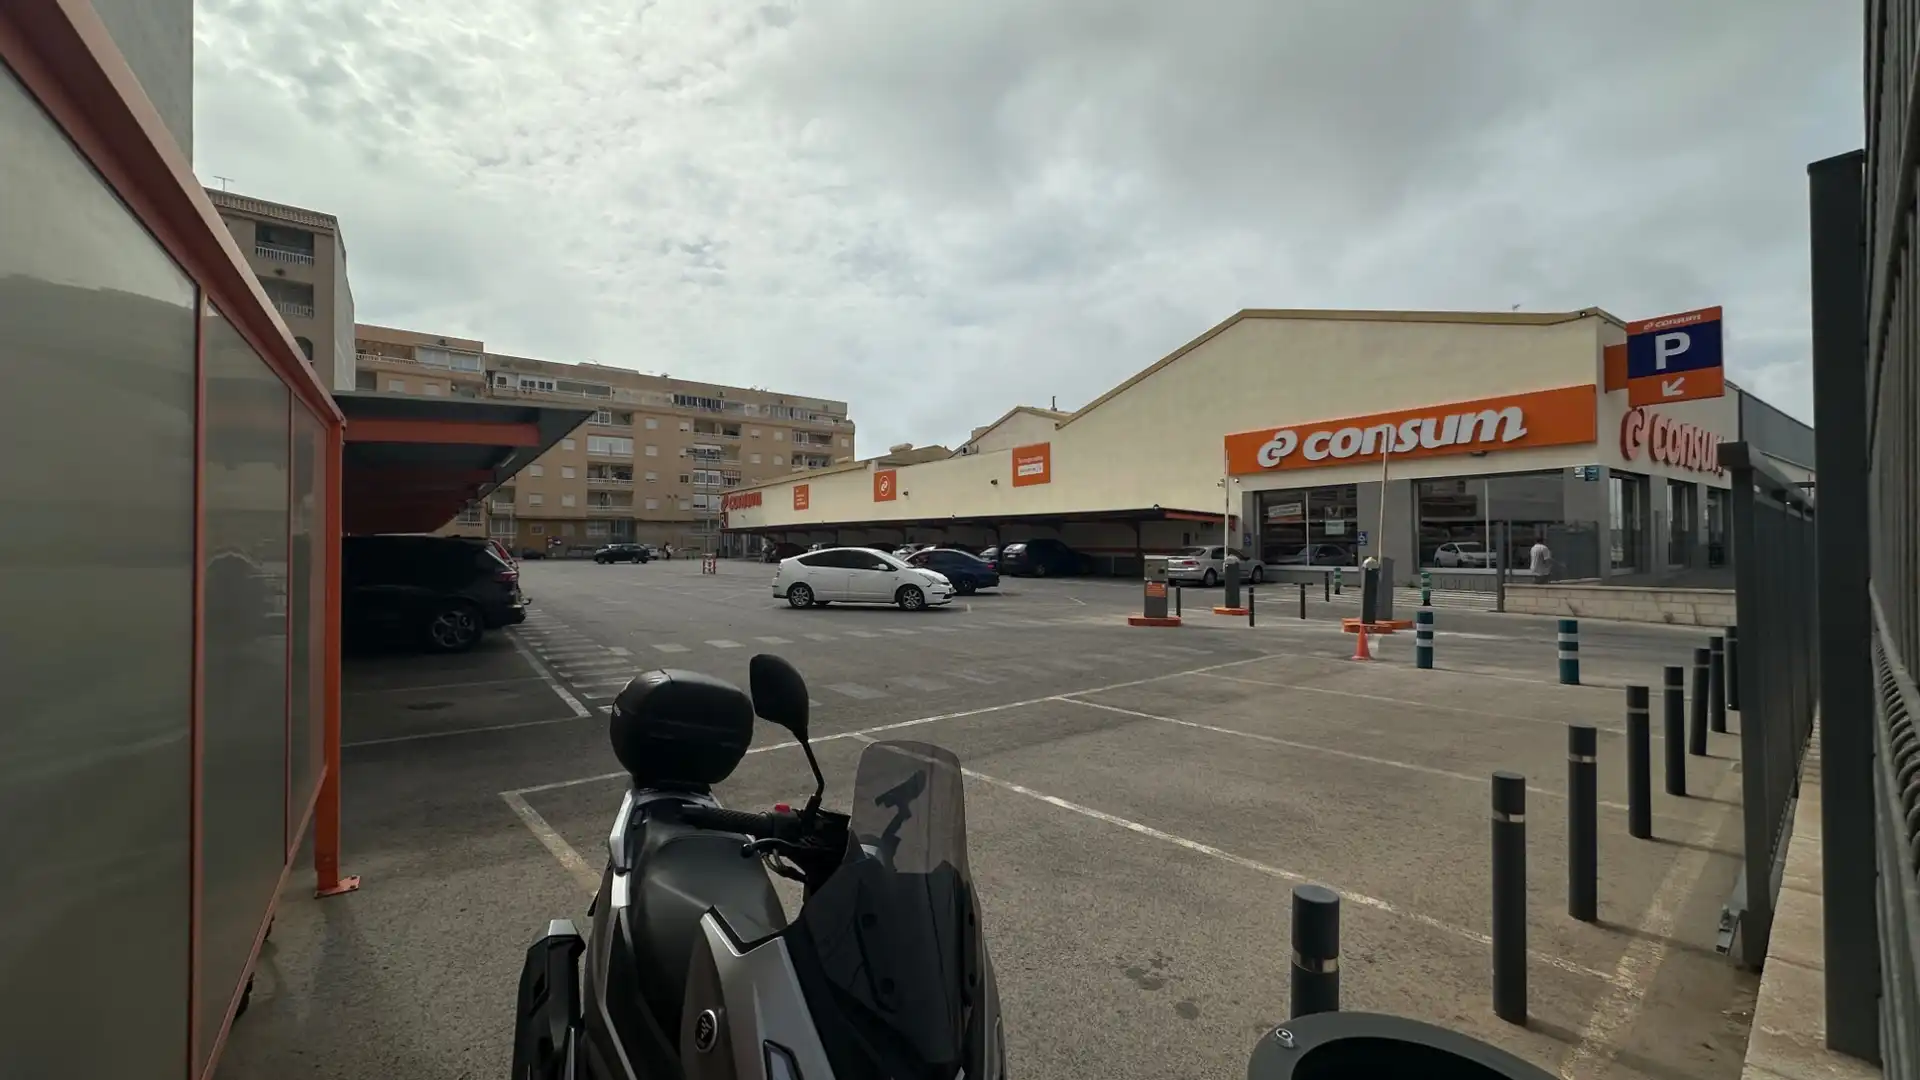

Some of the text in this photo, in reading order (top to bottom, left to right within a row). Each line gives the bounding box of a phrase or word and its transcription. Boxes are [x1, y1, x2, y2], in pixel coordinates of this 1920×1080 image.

[1655, 313, 1702, 328] consum
[1655, 331, 1691, 370] P
[1302, 406, 1527, 461] consum
